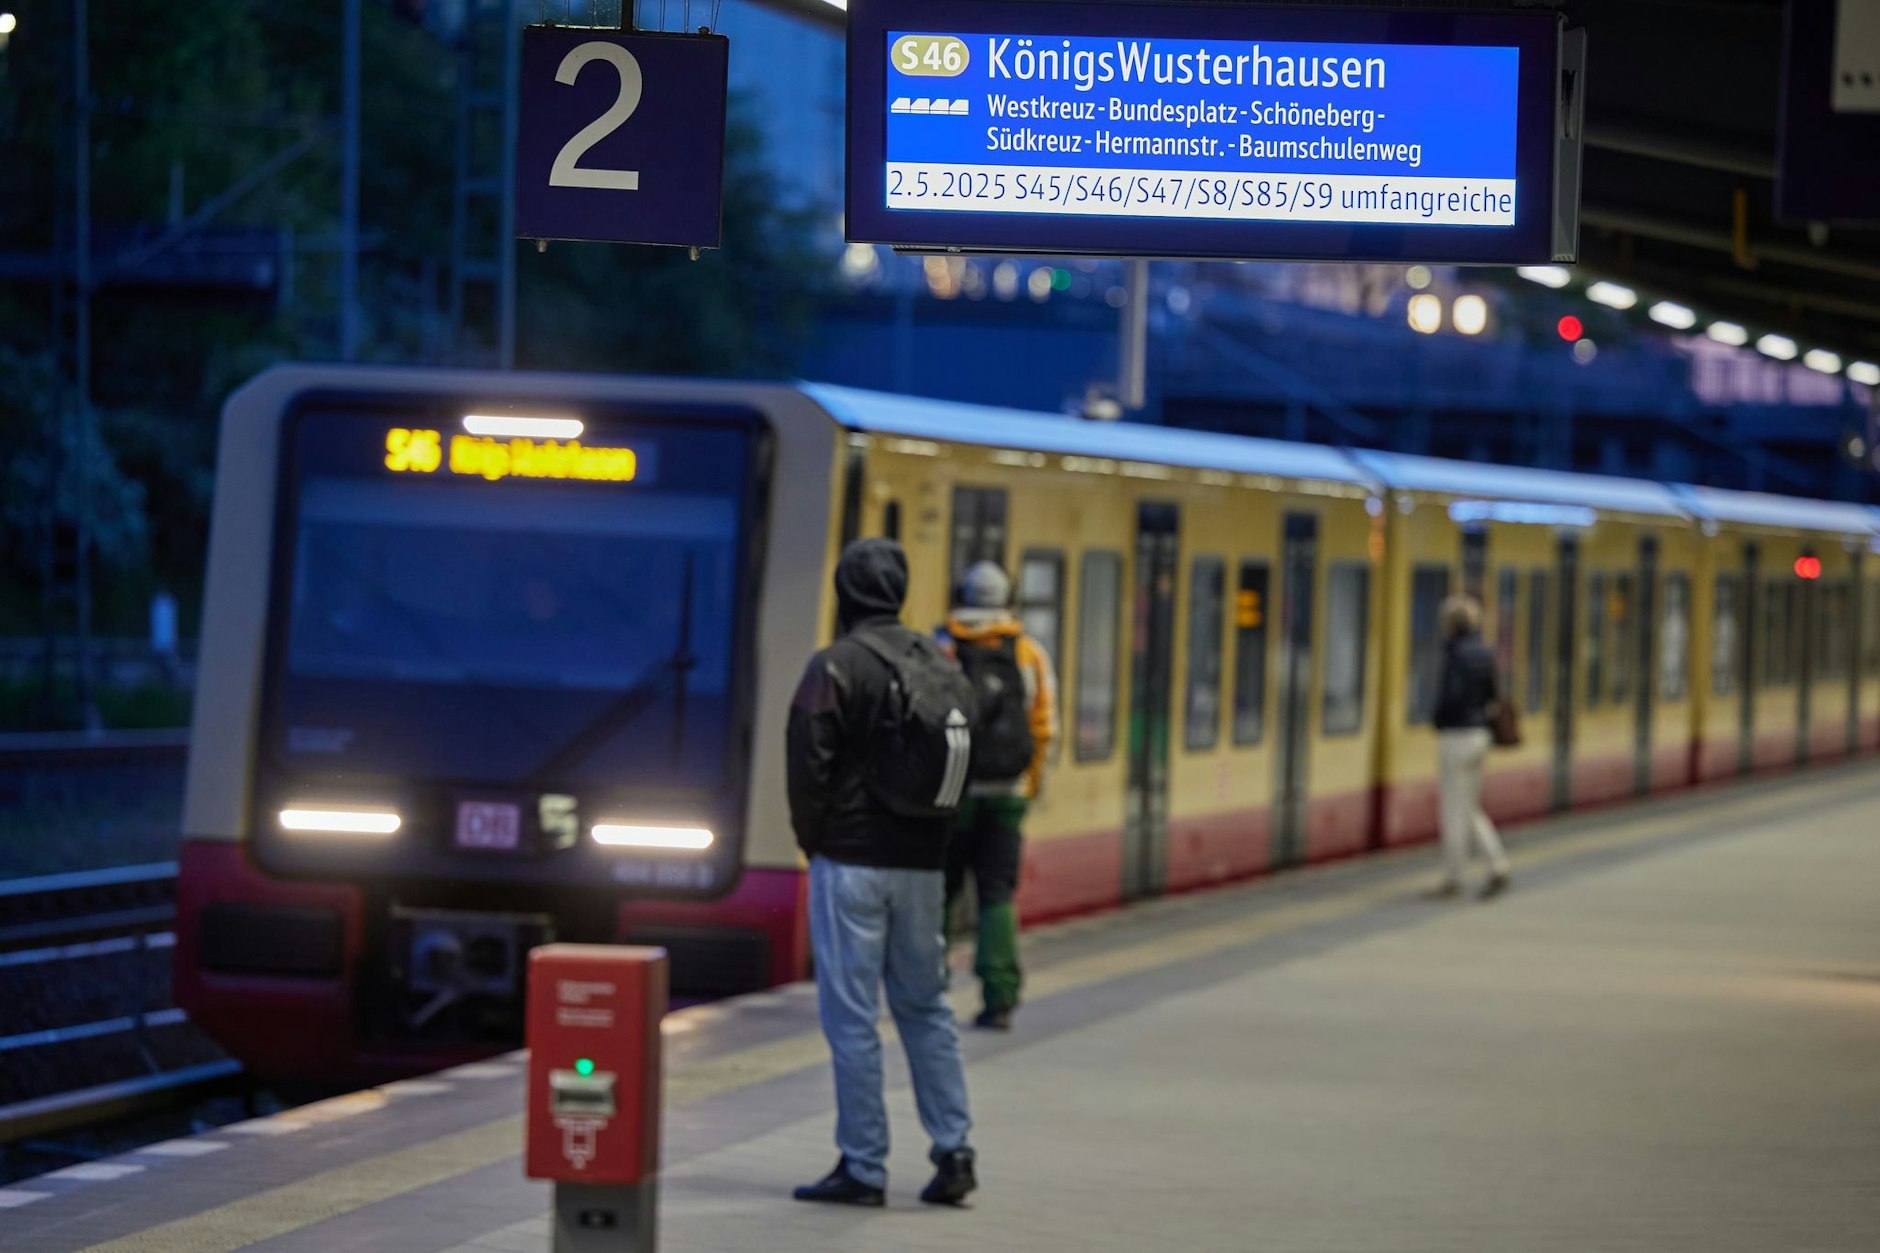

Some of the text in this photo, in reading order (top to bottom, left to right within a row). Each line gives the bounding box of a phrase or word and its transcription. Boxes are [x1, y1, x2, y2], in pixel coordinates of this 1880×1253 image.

[988, 37, 1386, 92] KönigsWusterhausen
[549, 41, 644, 191] 2
[889, 169, 1512, 217] 2.5.2025 S45/S46/S47/S8/S85/S9 umfangreiche
